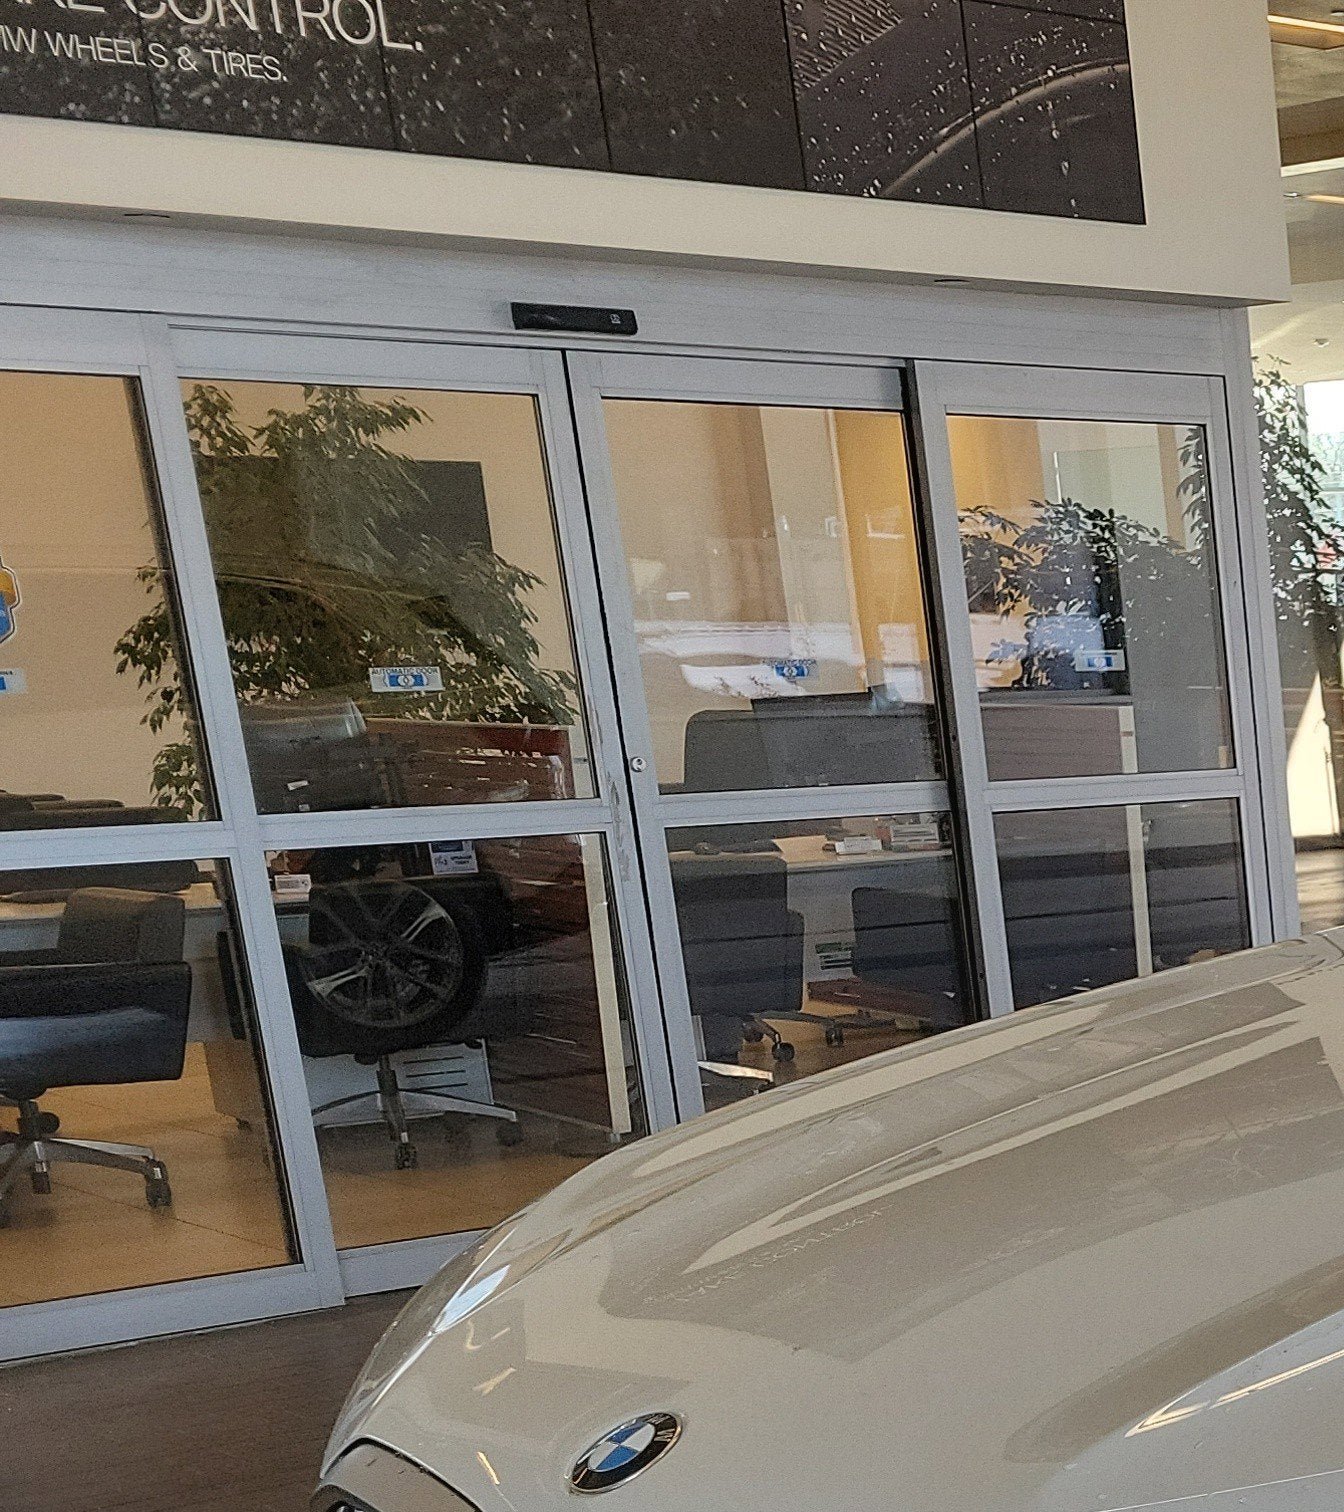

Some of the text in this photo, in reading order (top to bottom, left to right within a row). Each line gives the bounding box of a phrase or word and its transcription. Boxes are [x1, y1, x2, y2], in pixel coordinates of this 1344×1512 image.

[44, 30, 170, 69] WHEELS
[177, 46, 199, 72] &
[202, 48, 289, 83] TIRES.
